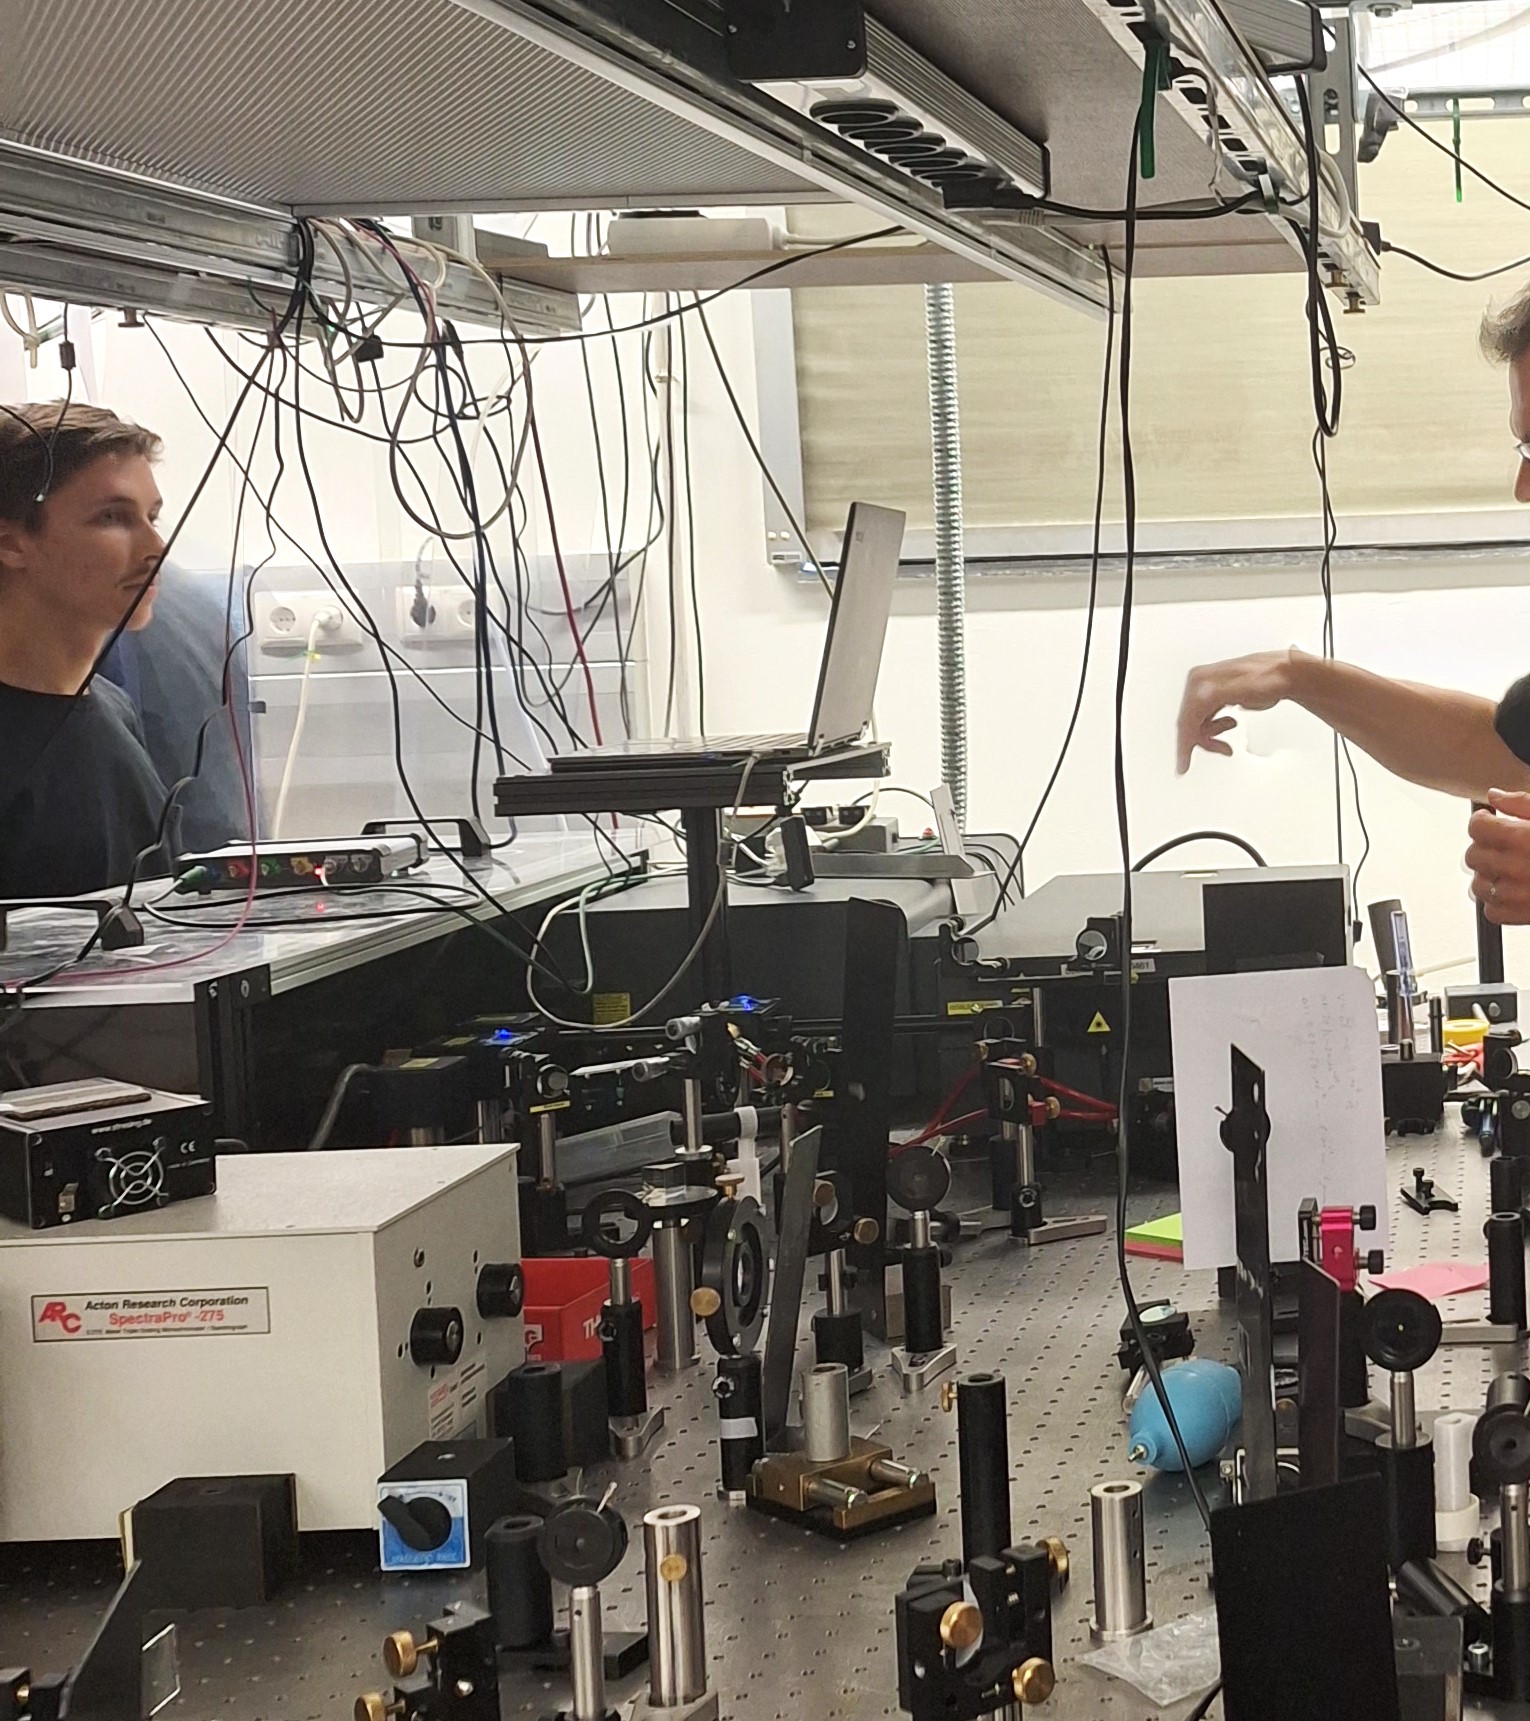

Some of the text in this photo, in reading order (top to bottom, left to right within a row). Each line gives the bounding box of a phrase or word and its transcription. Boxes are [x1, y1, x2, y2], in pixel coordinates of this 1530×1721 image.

[84, 1295, 248, 1310] Acton Research Corporation
[38, 1301, 82, 1334] ARC
